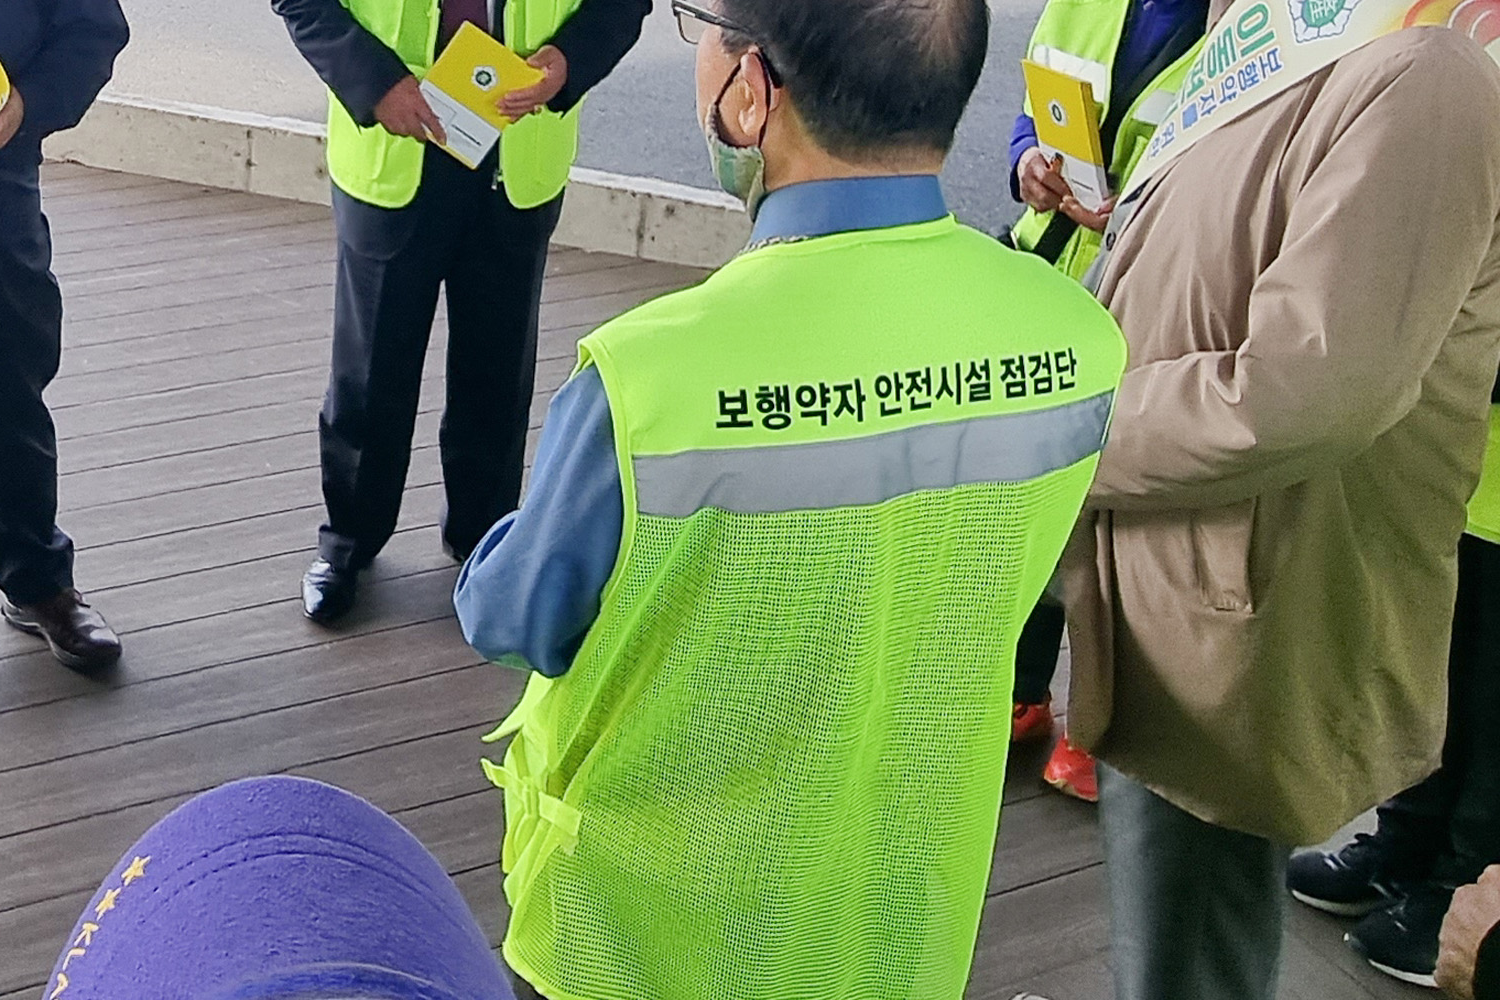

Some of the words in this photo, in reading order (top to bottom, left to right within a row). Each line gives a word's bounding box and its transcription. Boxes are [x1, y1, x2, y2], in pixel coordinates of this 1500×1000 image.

[715, 377, 867, 431] 보행약자
[874, 357, 992, 417] 안전시설
[1000, 346, 1078, 399] 점검단
